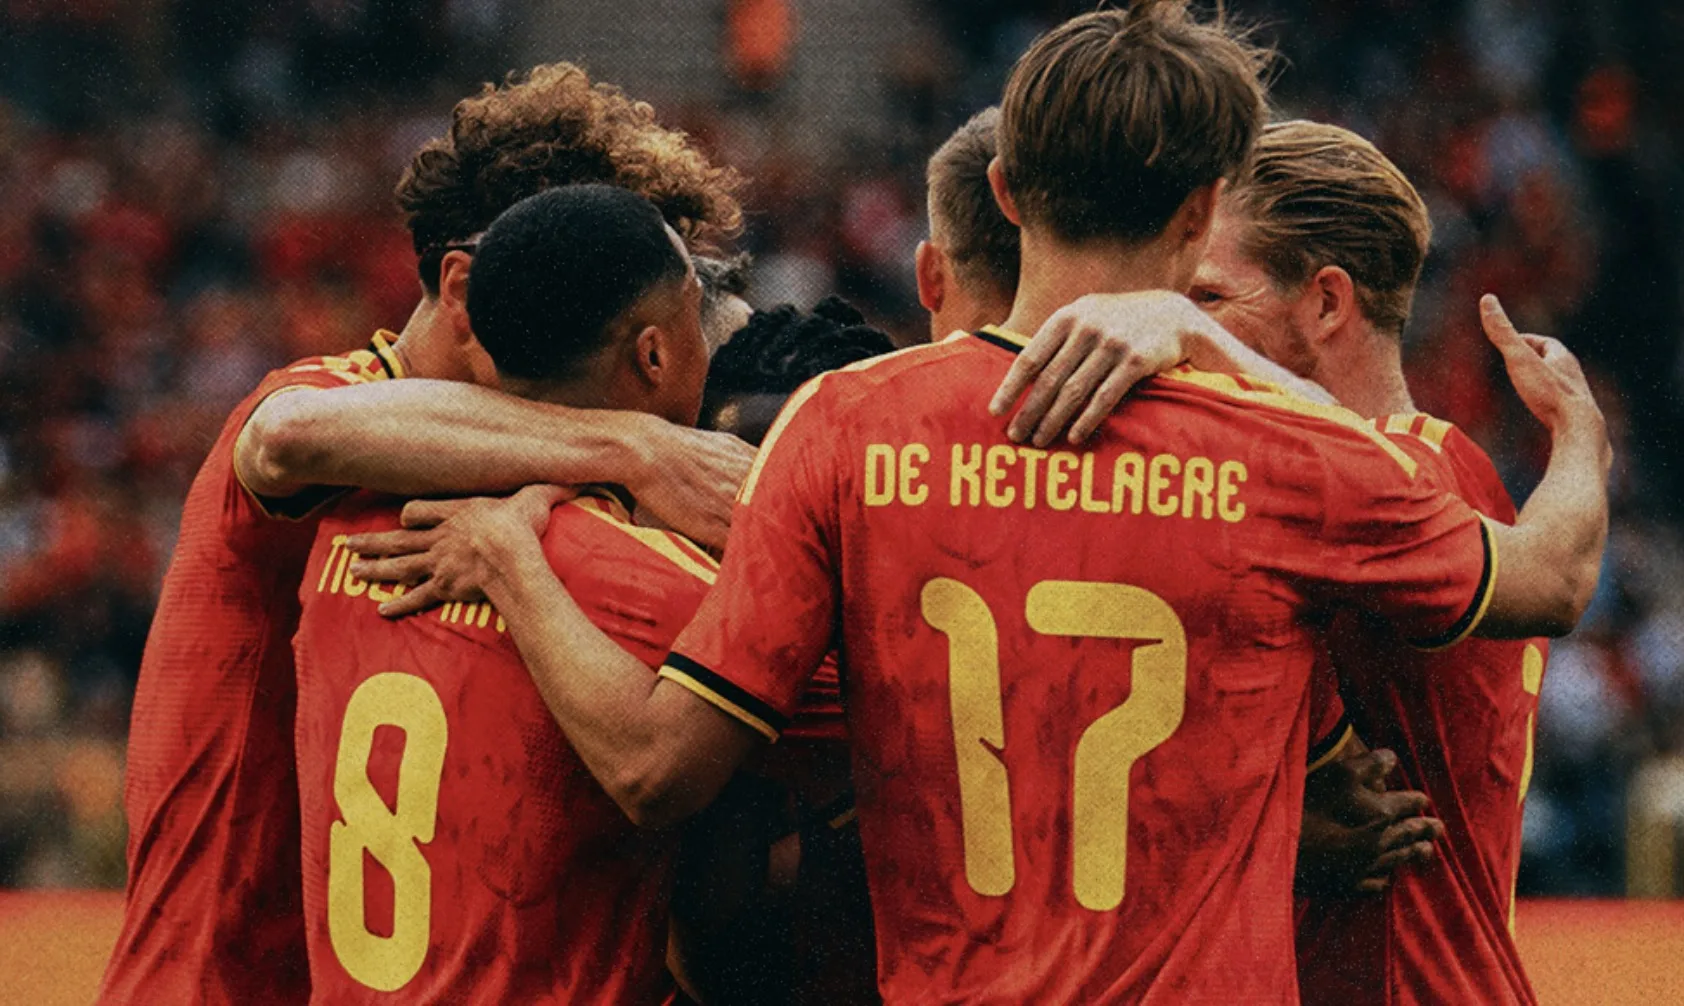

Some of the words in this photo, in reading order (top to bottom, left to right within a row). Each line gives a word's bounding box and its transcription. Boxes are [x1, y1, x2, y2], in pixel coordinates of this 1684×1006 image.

[864, 443, 930, 506] DE
[950, 443, 1248, 523] KETELAERE
[328, 672, 448, 991] 8
[920, 577, 1187, 911] 17
